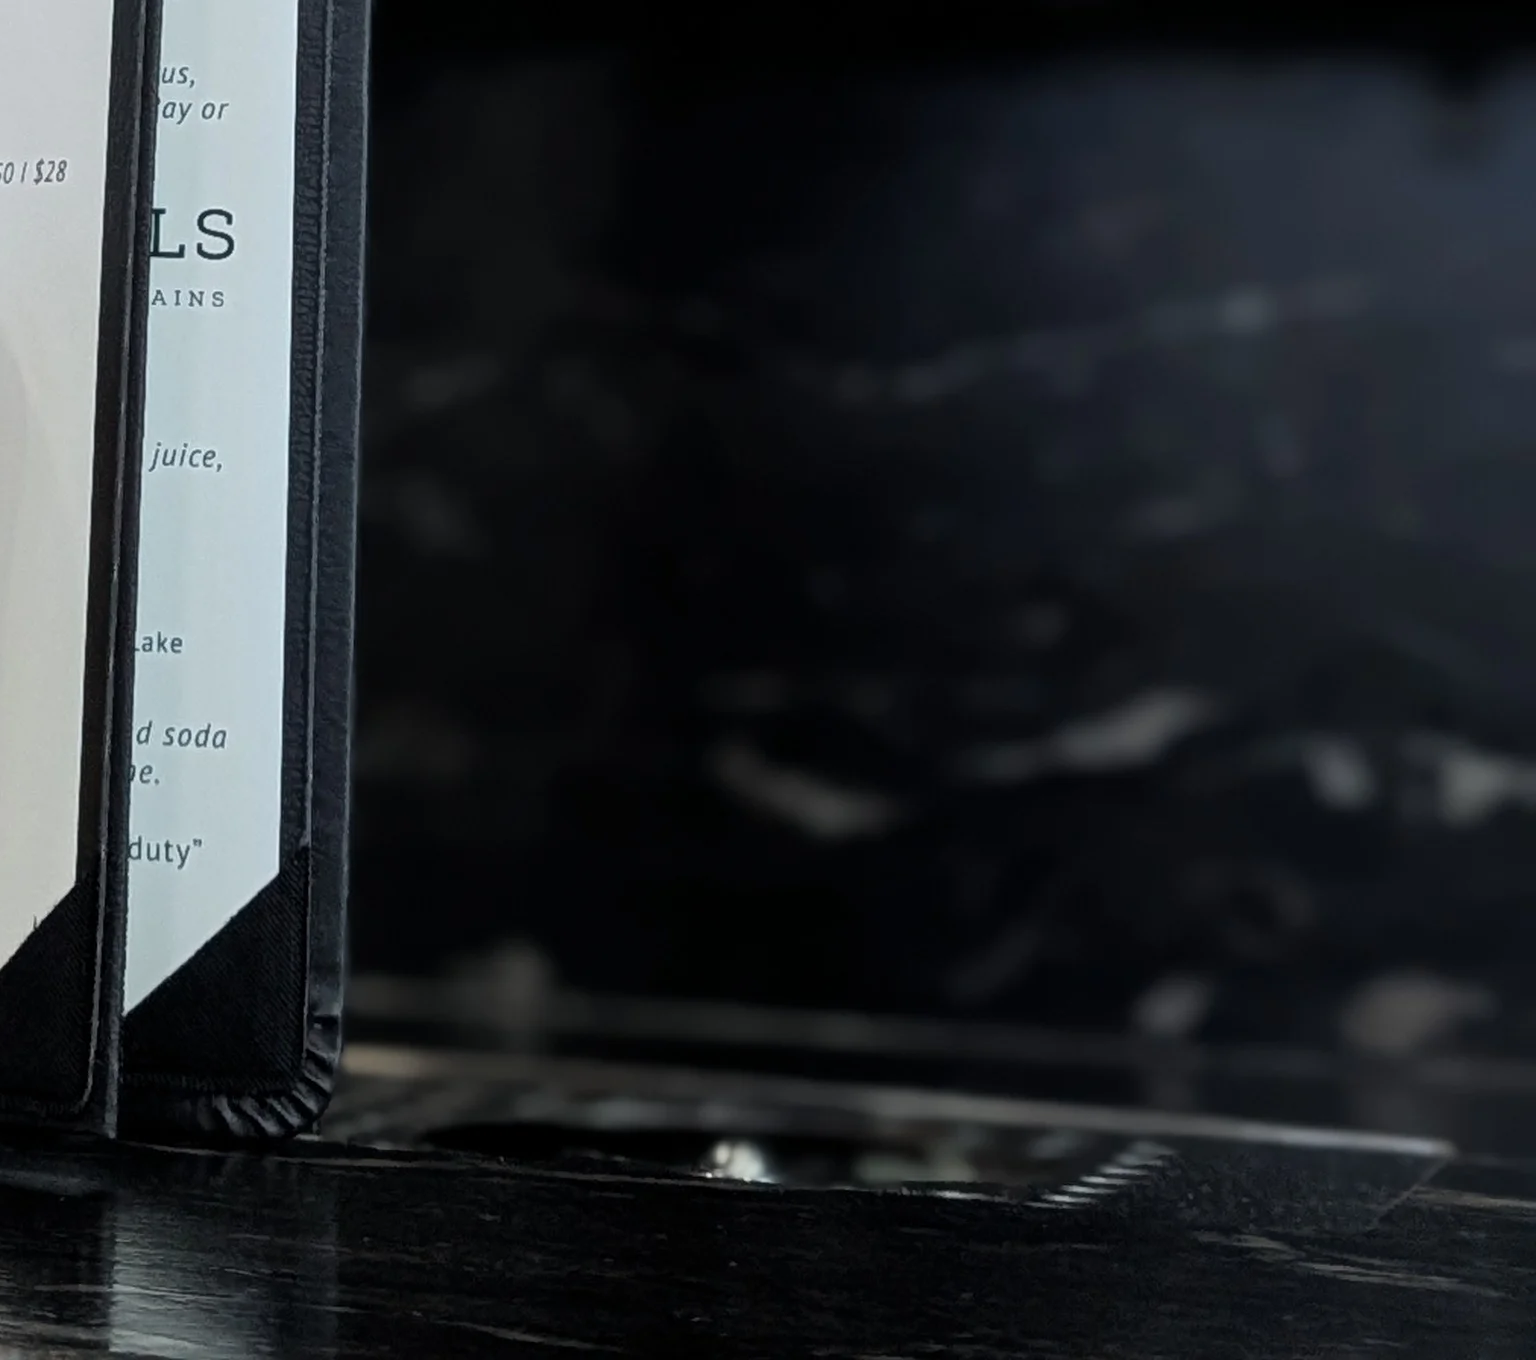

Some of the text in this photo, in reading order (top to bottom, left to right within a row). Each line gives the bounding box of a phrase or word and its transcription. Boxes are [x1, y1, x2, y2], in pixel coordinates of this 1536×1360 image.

[201, 101, 229, 120] or
[32, 158, 68, 186] $28
[148, 442, 223, 473] juice,
[162, 723, 228, 749] soda
